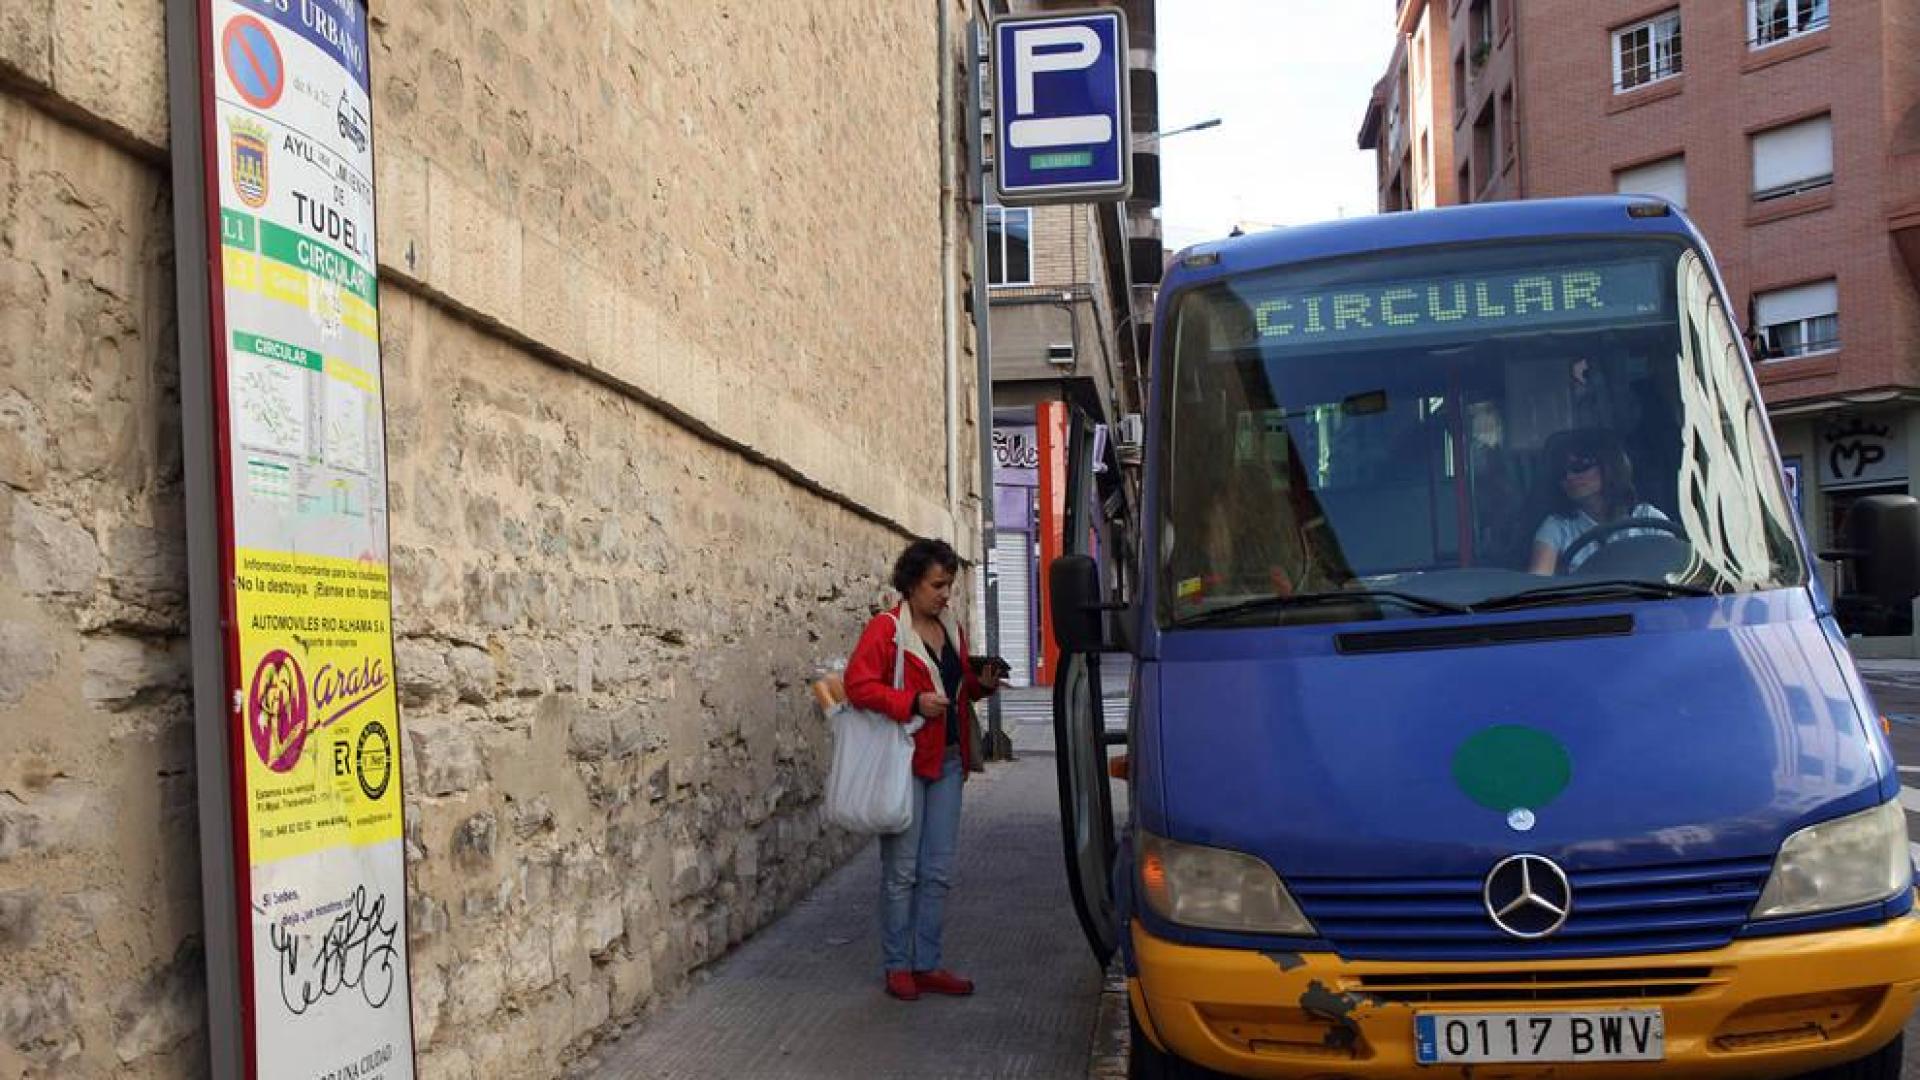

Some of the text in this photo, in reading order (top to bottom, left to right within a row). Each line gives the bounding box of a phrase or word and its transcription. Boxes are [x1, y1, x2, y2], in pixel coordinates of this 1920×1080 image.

[1013, 25, 1102, 115] P
[298, 239, 366, 298] CIRCULAR
[1256, 269, 1606, 337] CIRCULAR
[255, 338, 308, 365] CIRCULAR
[238, 575, 253, 591] No
[255, 576, 265, 592] la
[252, 614, 319, 632] AUTOMOVILES
[338, 618, 372, 633] ALHAMA
[313, 657, 385, 709] arasa
[1446, 1015, 1652, 1056] 0117 BWV
